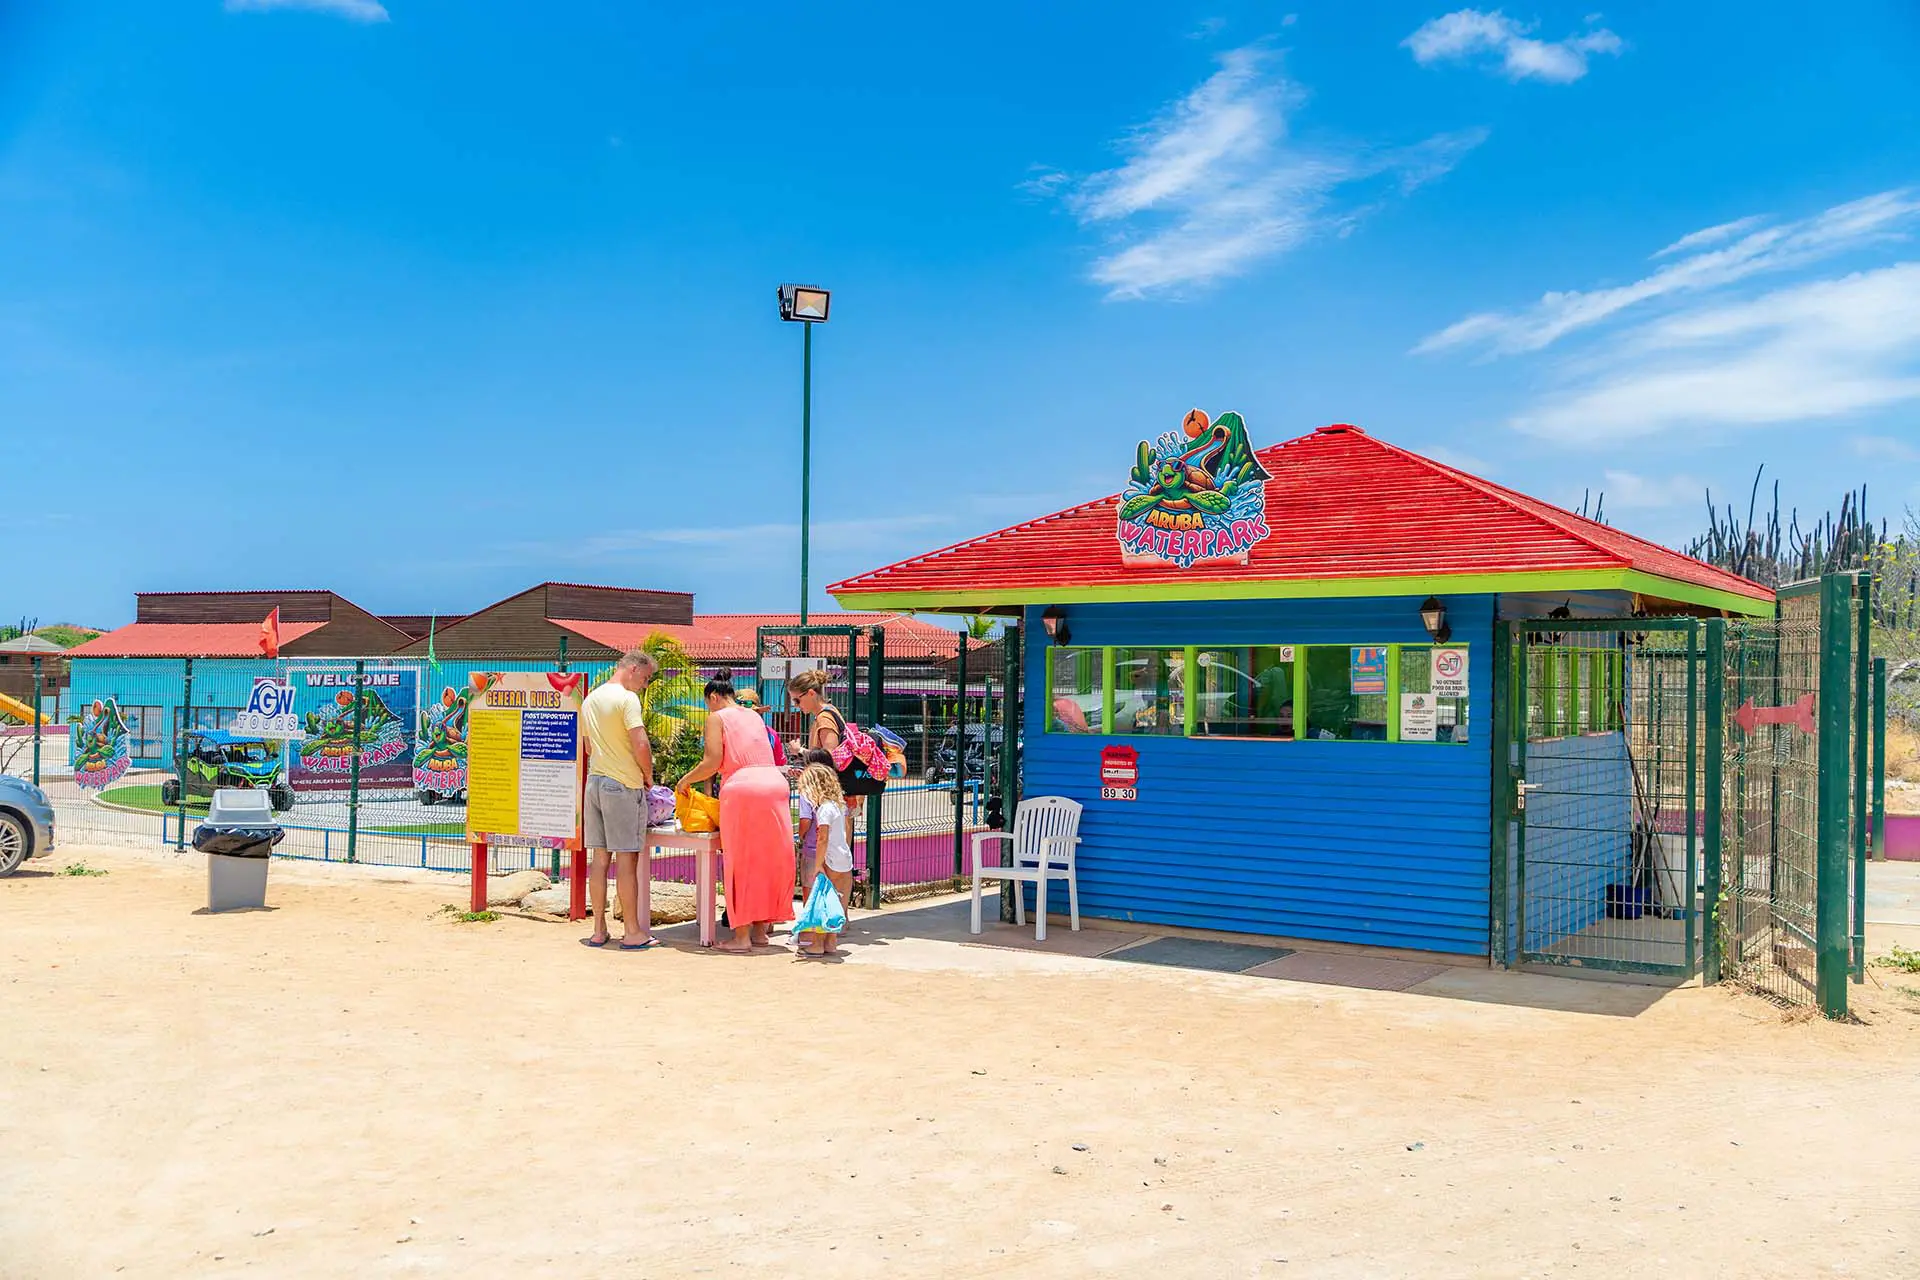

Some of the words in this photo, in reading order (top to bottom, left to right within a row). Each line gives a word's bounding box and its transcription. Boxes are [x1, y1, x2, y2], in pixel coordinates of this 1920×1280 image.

[1147, 509, 1204, 531] ARUBA
[1119, 515, 1268, 557] WATERPARK
[306, 674, 401, 686] WELCOME
[247, 682, 294, 719] AGW
[486, 689, 528, 708] GENERAL
[530, 690, 561, 708] RULES
[239, 714, 296, 731] TOURS
[302, 740, 408, 770] WATEPARK
[320, 745, 364, 758] ARUB
[414, 768, 468, 789] WATERP
[1103, 788, 1116, 798] 89
[1122, 789, 1134, 799] 30
